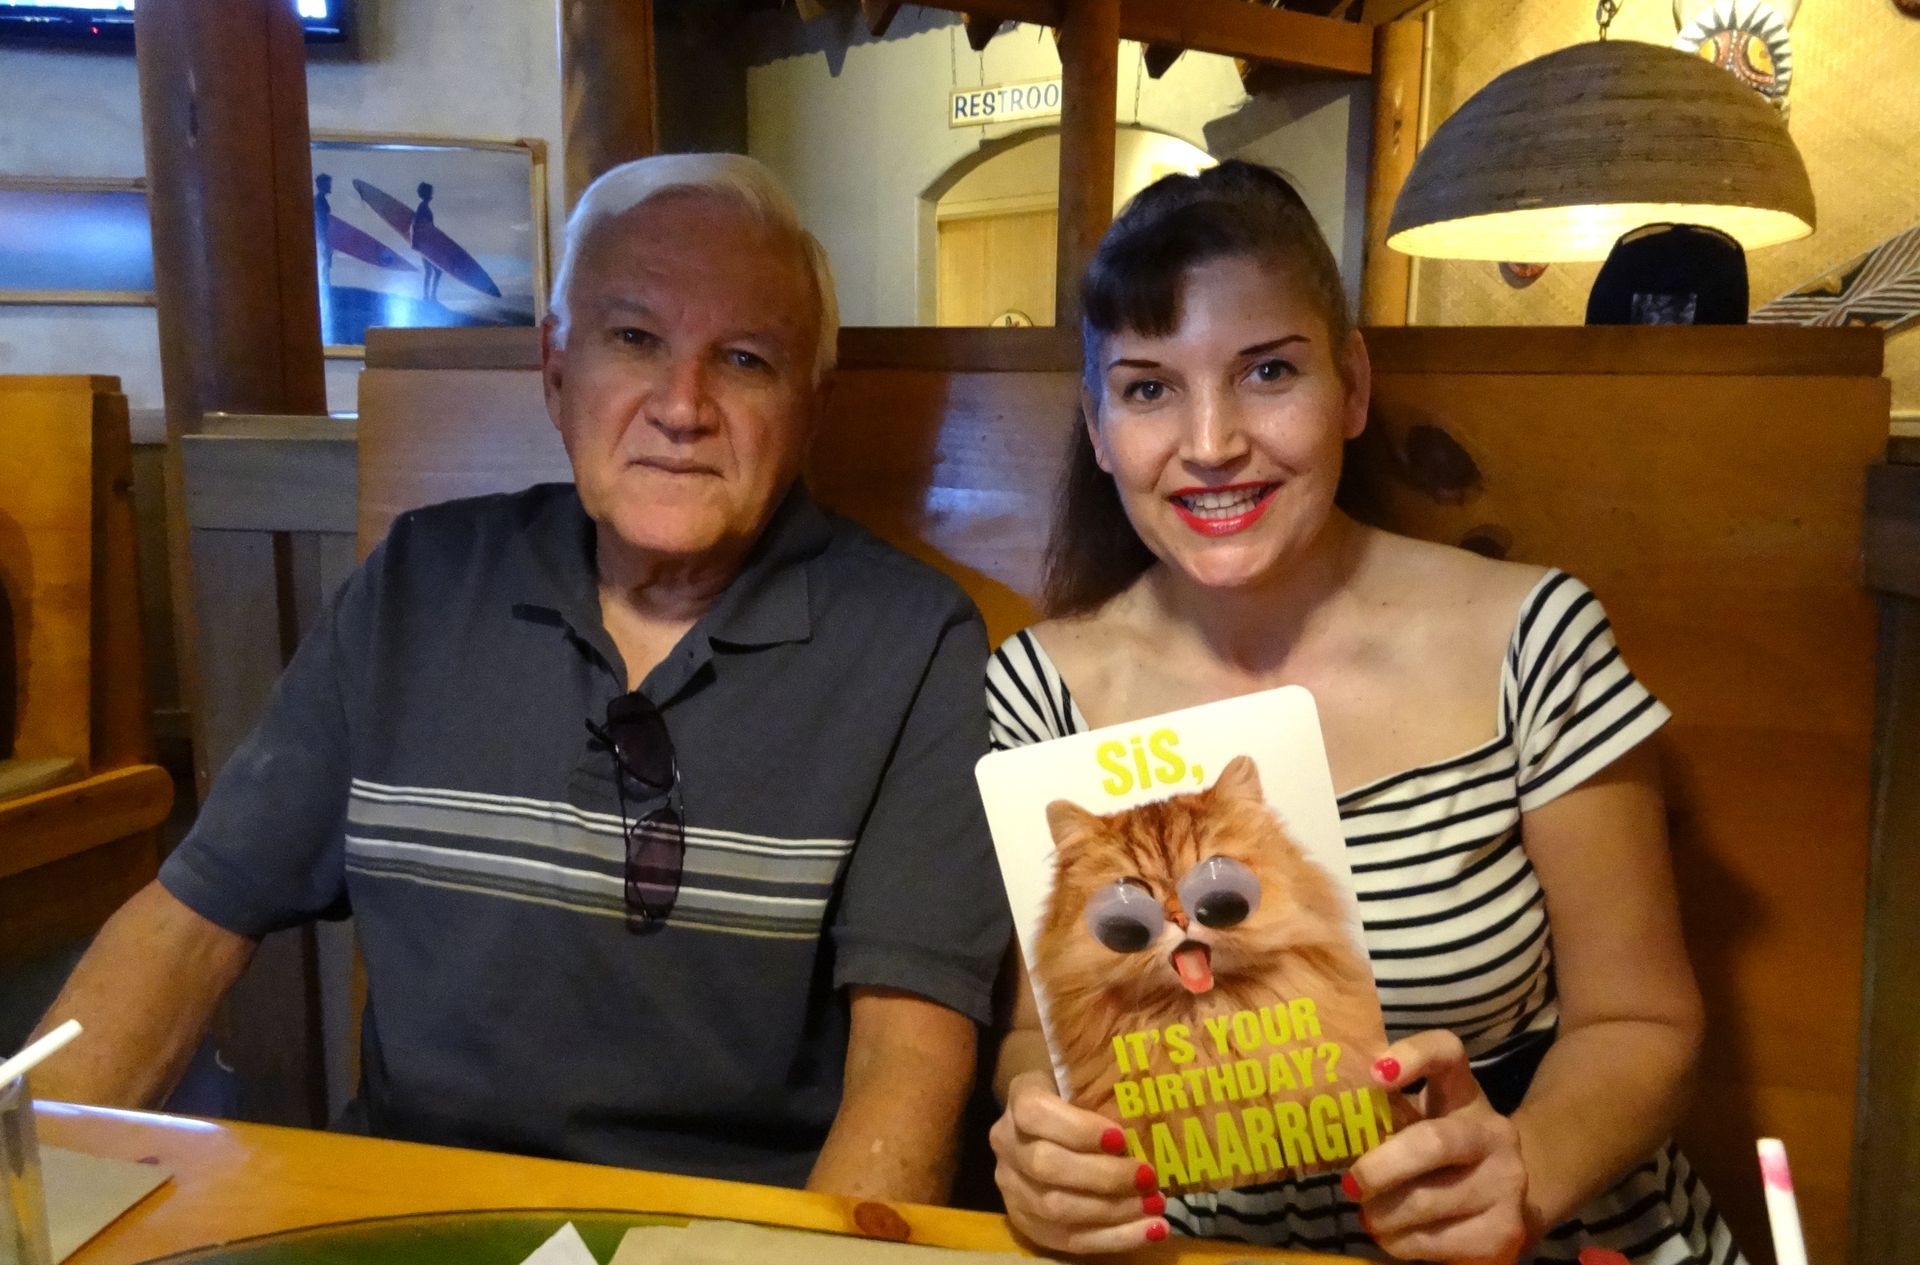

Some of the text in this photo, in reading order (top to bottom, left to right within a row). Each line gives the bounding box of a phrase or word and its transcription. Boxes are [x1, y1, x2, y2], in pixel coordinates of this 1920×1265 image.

[955, 84, 1060, 119] RESTROO
[1112, 997, 1322, 1074] IT'S YOUR
[1113, 1042, 1342, 1119] BIRTHDAY?
